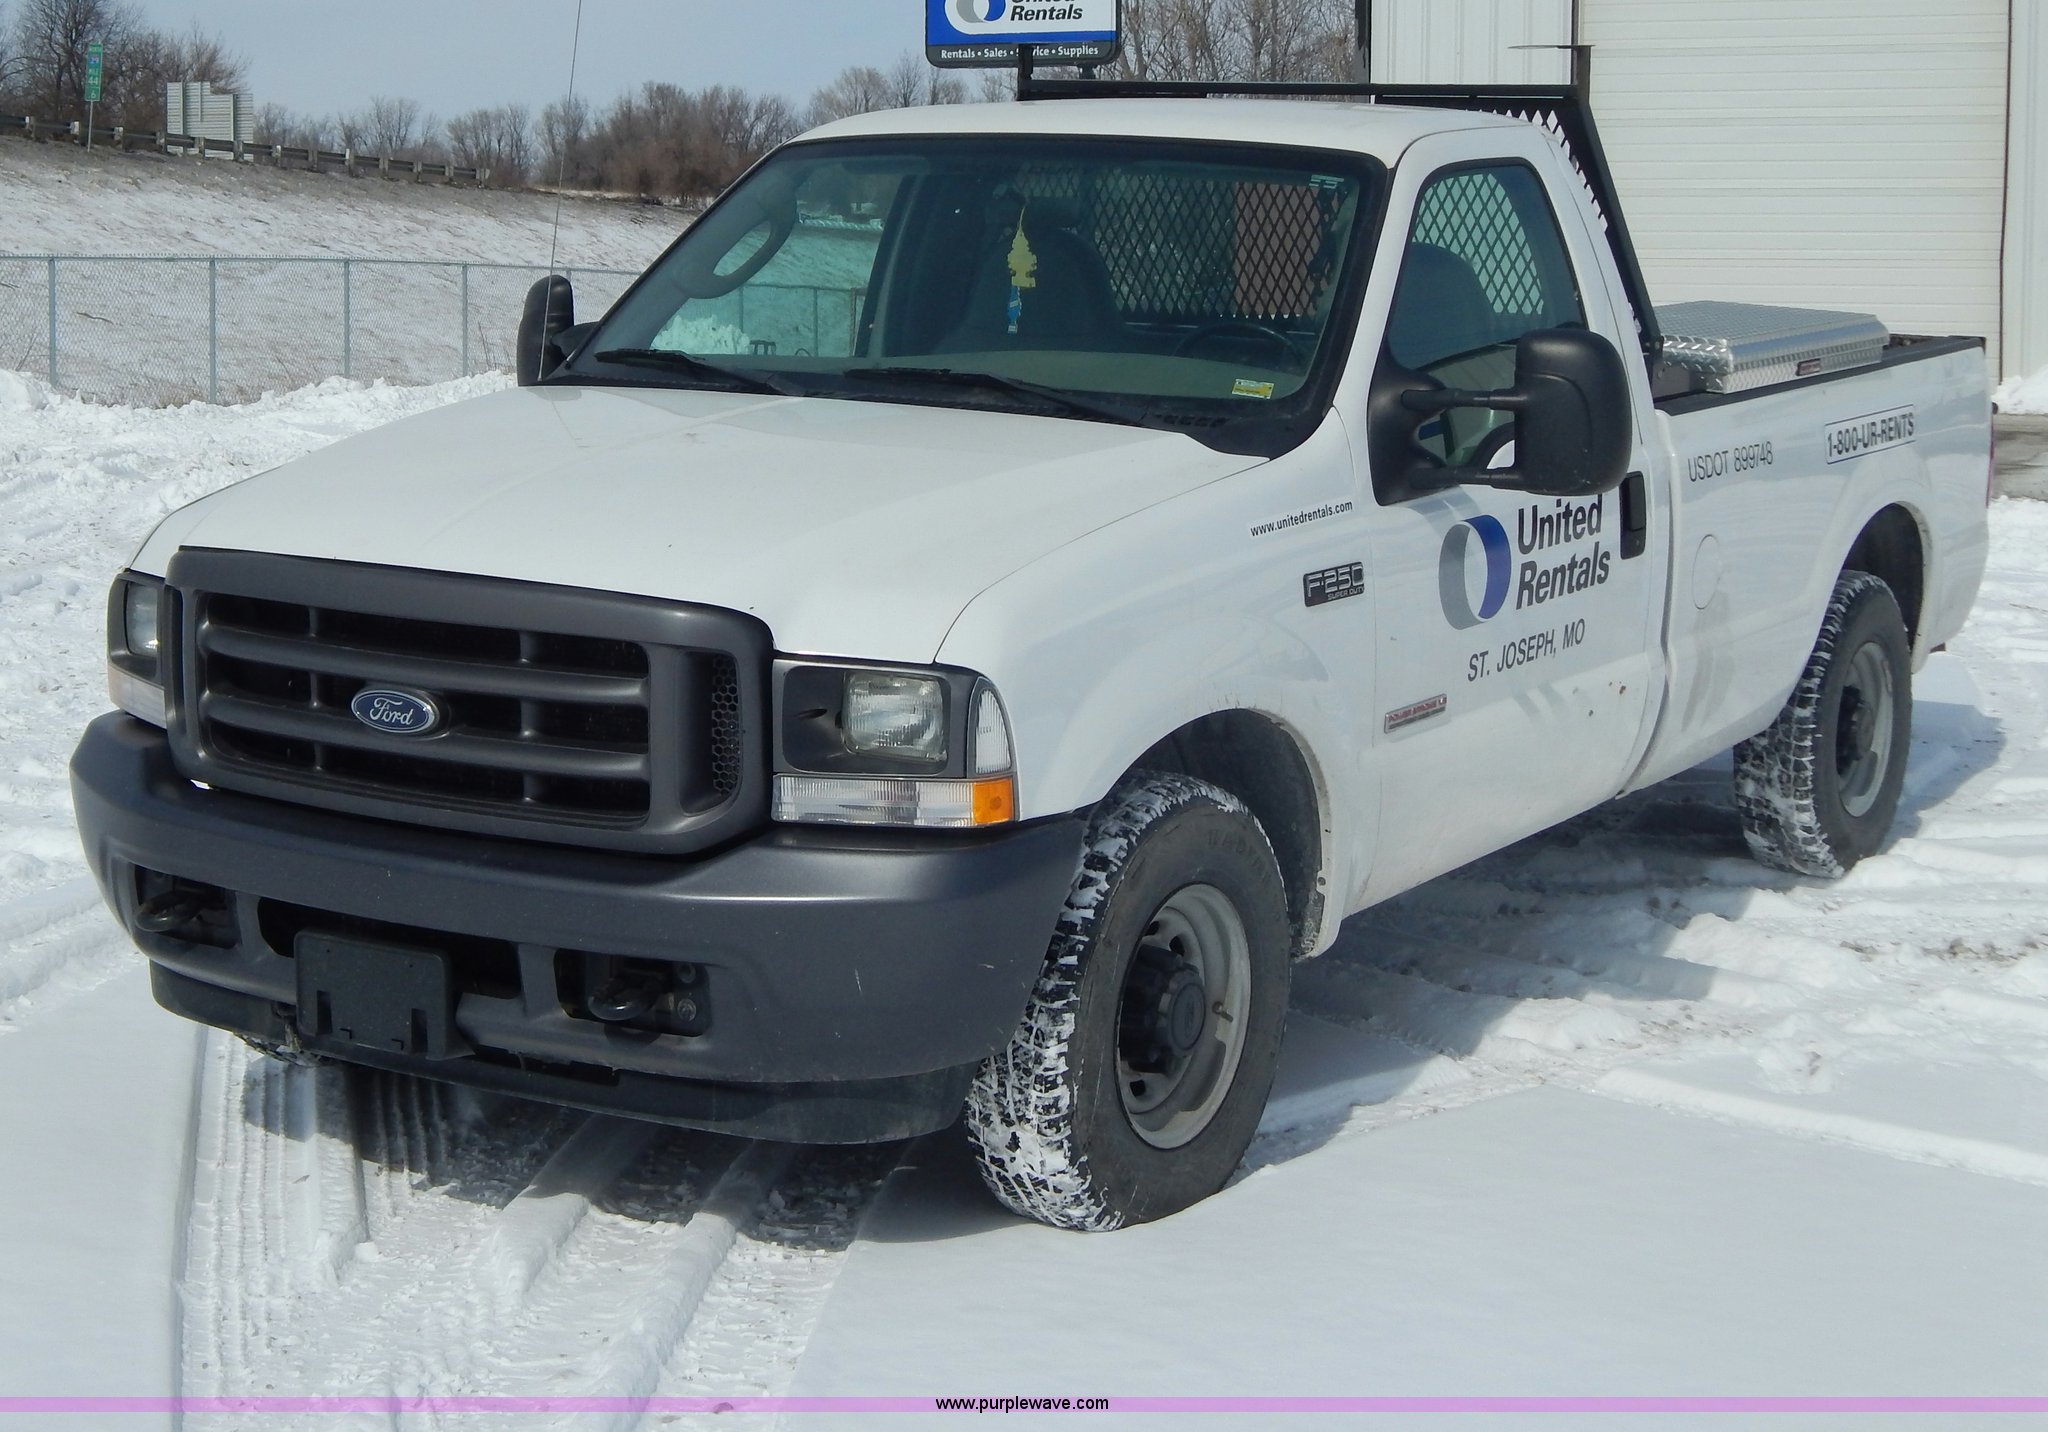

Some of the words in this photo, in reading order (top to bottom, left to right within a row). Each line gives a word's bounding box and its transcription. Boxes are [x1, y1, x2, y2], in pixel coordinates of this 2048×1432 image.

[1010, 4, 1083, 21] Rentals
[941, 48, 975, 59] Rentals
[983, 48, 1007, 58] Sales
[1058, 44, 1098, 57] Supplies
[1827, 412, 1914, 457] 1-800-UR-RENTS
[1687, 450, 1728, 482] USDOT
[1734, 441, 1773, 472] 899748
[1250, 501, 1353, 537] www.unitedrentals.com
[1517, 494, 1603, 555] United
[1516, 541, 1611, 610] Rentals
[1467, 651, 1490, 681] ST.
[1496, 628, 1557, 672] JOSEPH,
[1562, 618, 1586, 650] MO
[369, 697, 414, 725] Ford
